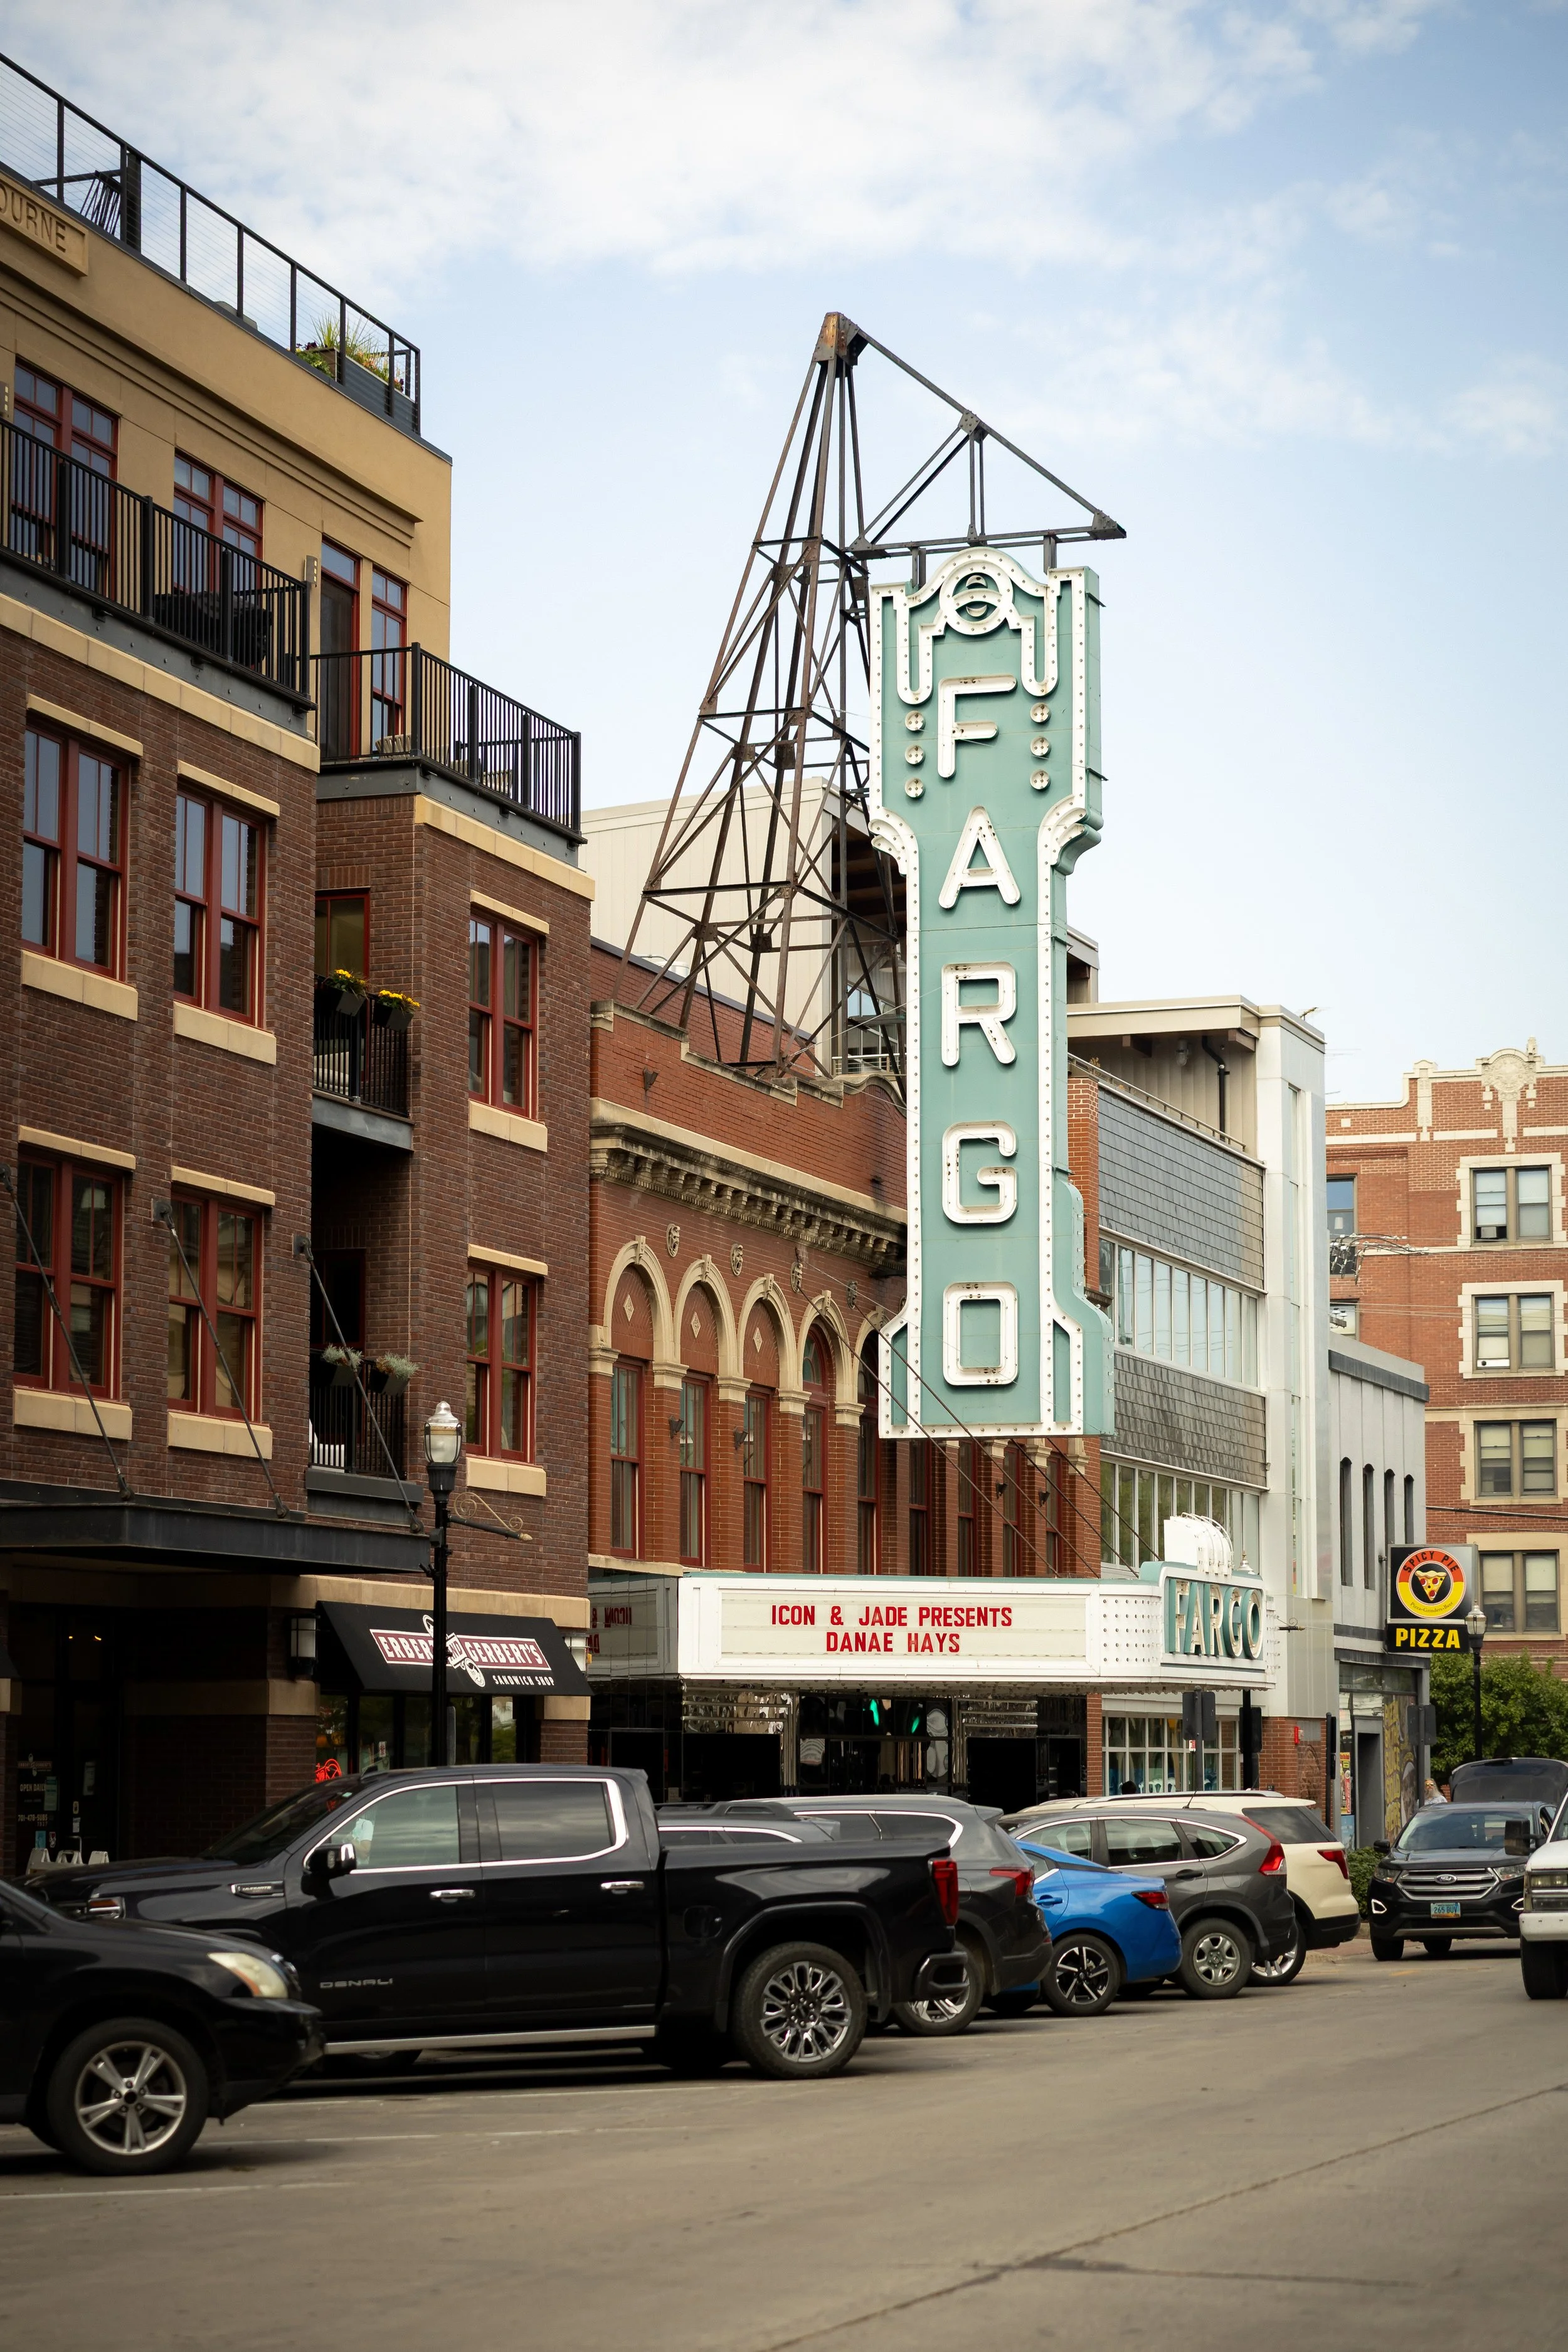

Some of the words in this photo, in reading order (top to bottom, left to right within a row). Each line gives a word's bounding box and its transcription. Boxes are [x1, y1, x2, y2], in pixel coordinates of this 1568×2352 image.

[937, 673, 1021, 1386] FARGO
[1403, 1550, 1434, 1573] SPICY
[1441, 1555, 1461, 1573] PIE
[771, 1605, 815, 1626] ICON
[830, 1605, 844, 1626] &
[859, 1606, 908, 1627] JADE
[918, 1607, 1012, 1627] PRESENTS
[1169, 1578, 1264, 1659] FARGO
[826, 1631, 894, 1652] DANAE
[908, 1632, 960, 1652] HAYS
[1396, 1628, 1461, 1649] PIZZA
[464, 1641, 543, 1664] GERBERT'S
[492, 1674, 534, 1686] SANDWICH
[537, 1676, 554, 1686] SHOP
[19, 1784, 33, 1792] OPEN
[320, 1977, 393, 1988] DENALI
